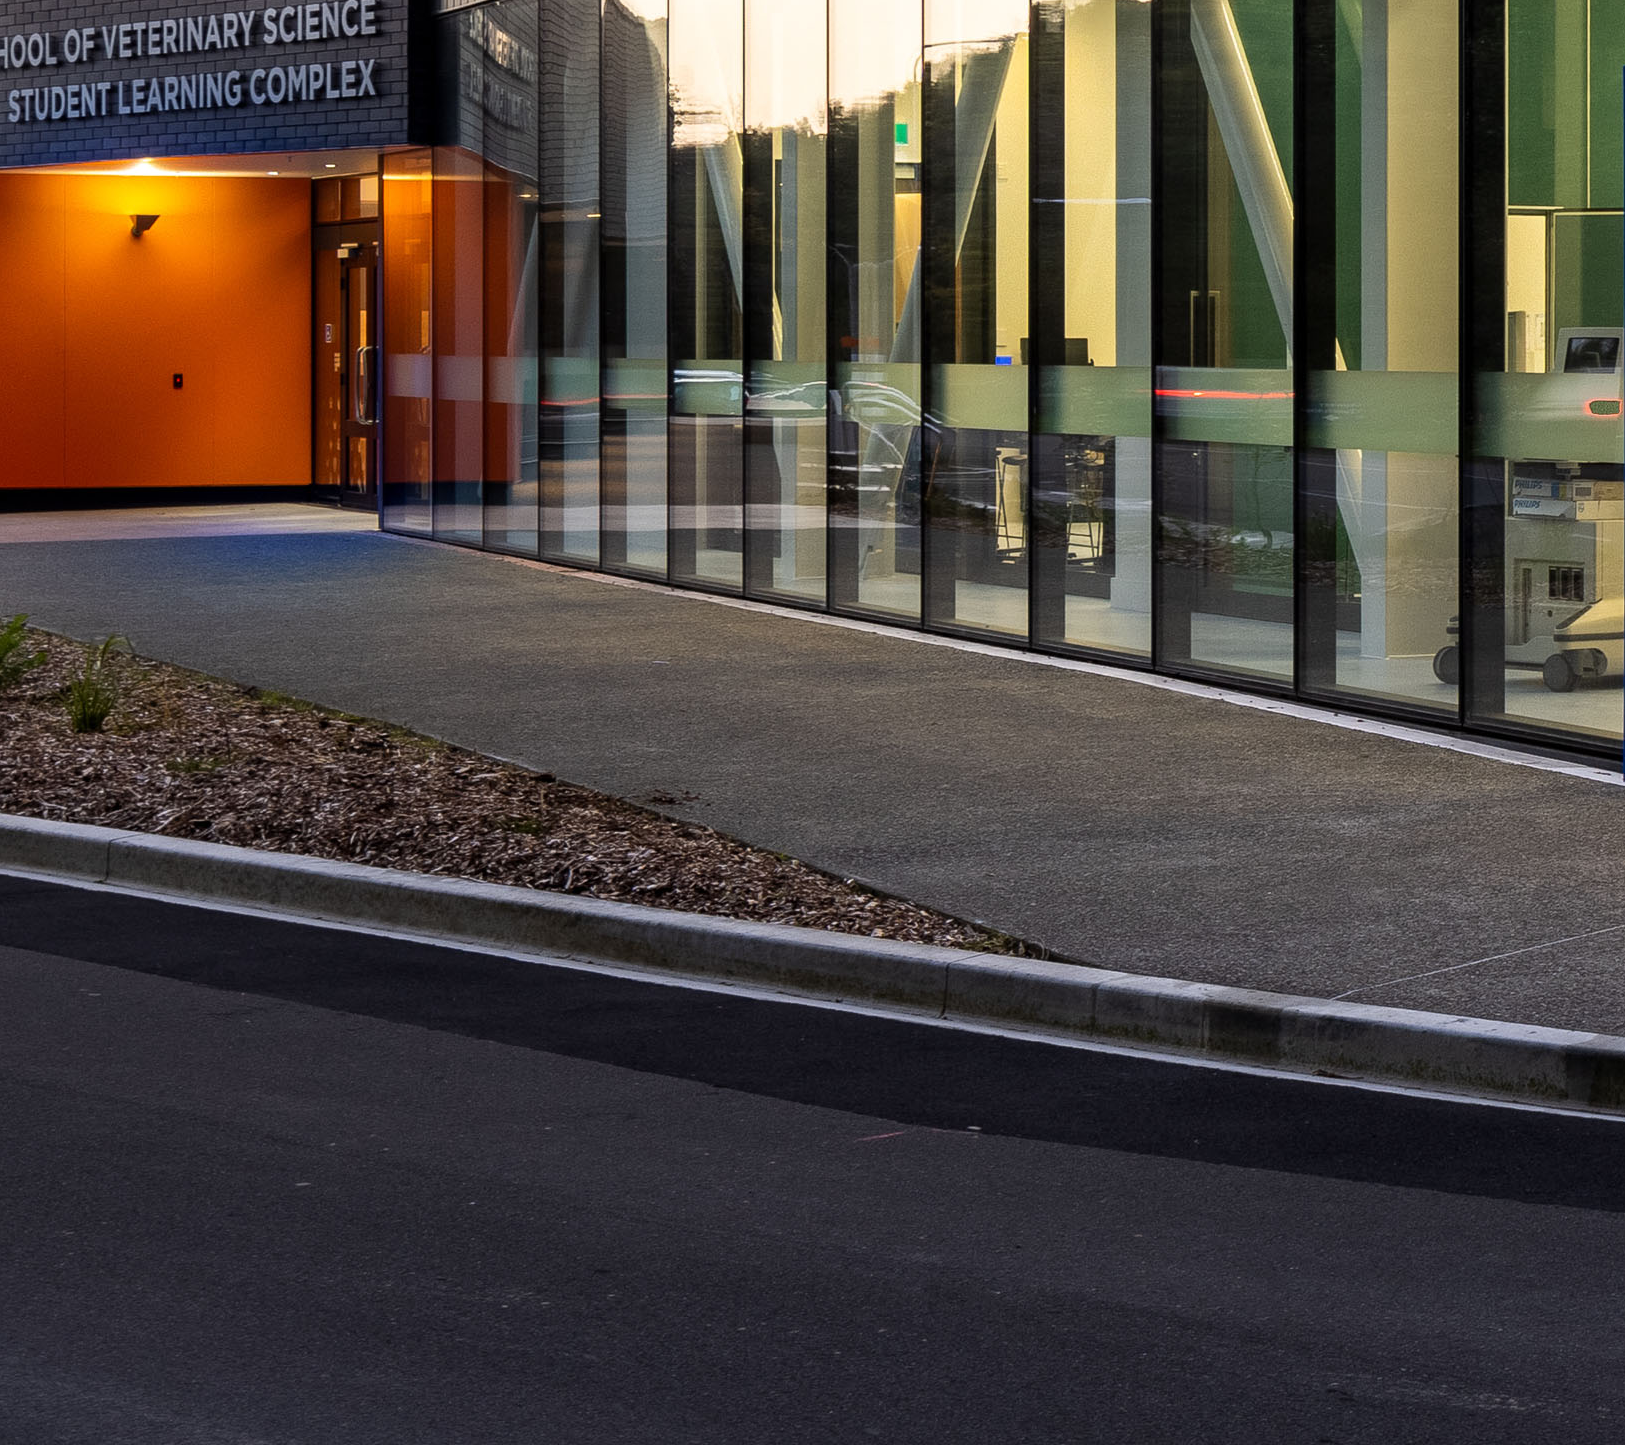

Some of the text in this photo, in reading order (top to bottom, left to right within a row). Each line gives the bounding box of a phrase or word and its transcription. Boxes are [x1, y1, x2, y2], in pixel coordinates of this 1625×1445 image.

[64, 27, 95, 64] OF
[102, 11, 256, 60] VETERINARY
[8, 59, 376, 123] STUDENT LEARNING COMPLEX
[1515, 480, 1543, 489] PHILIPS
[1514, 499, 1541, 509] PHILIPS
